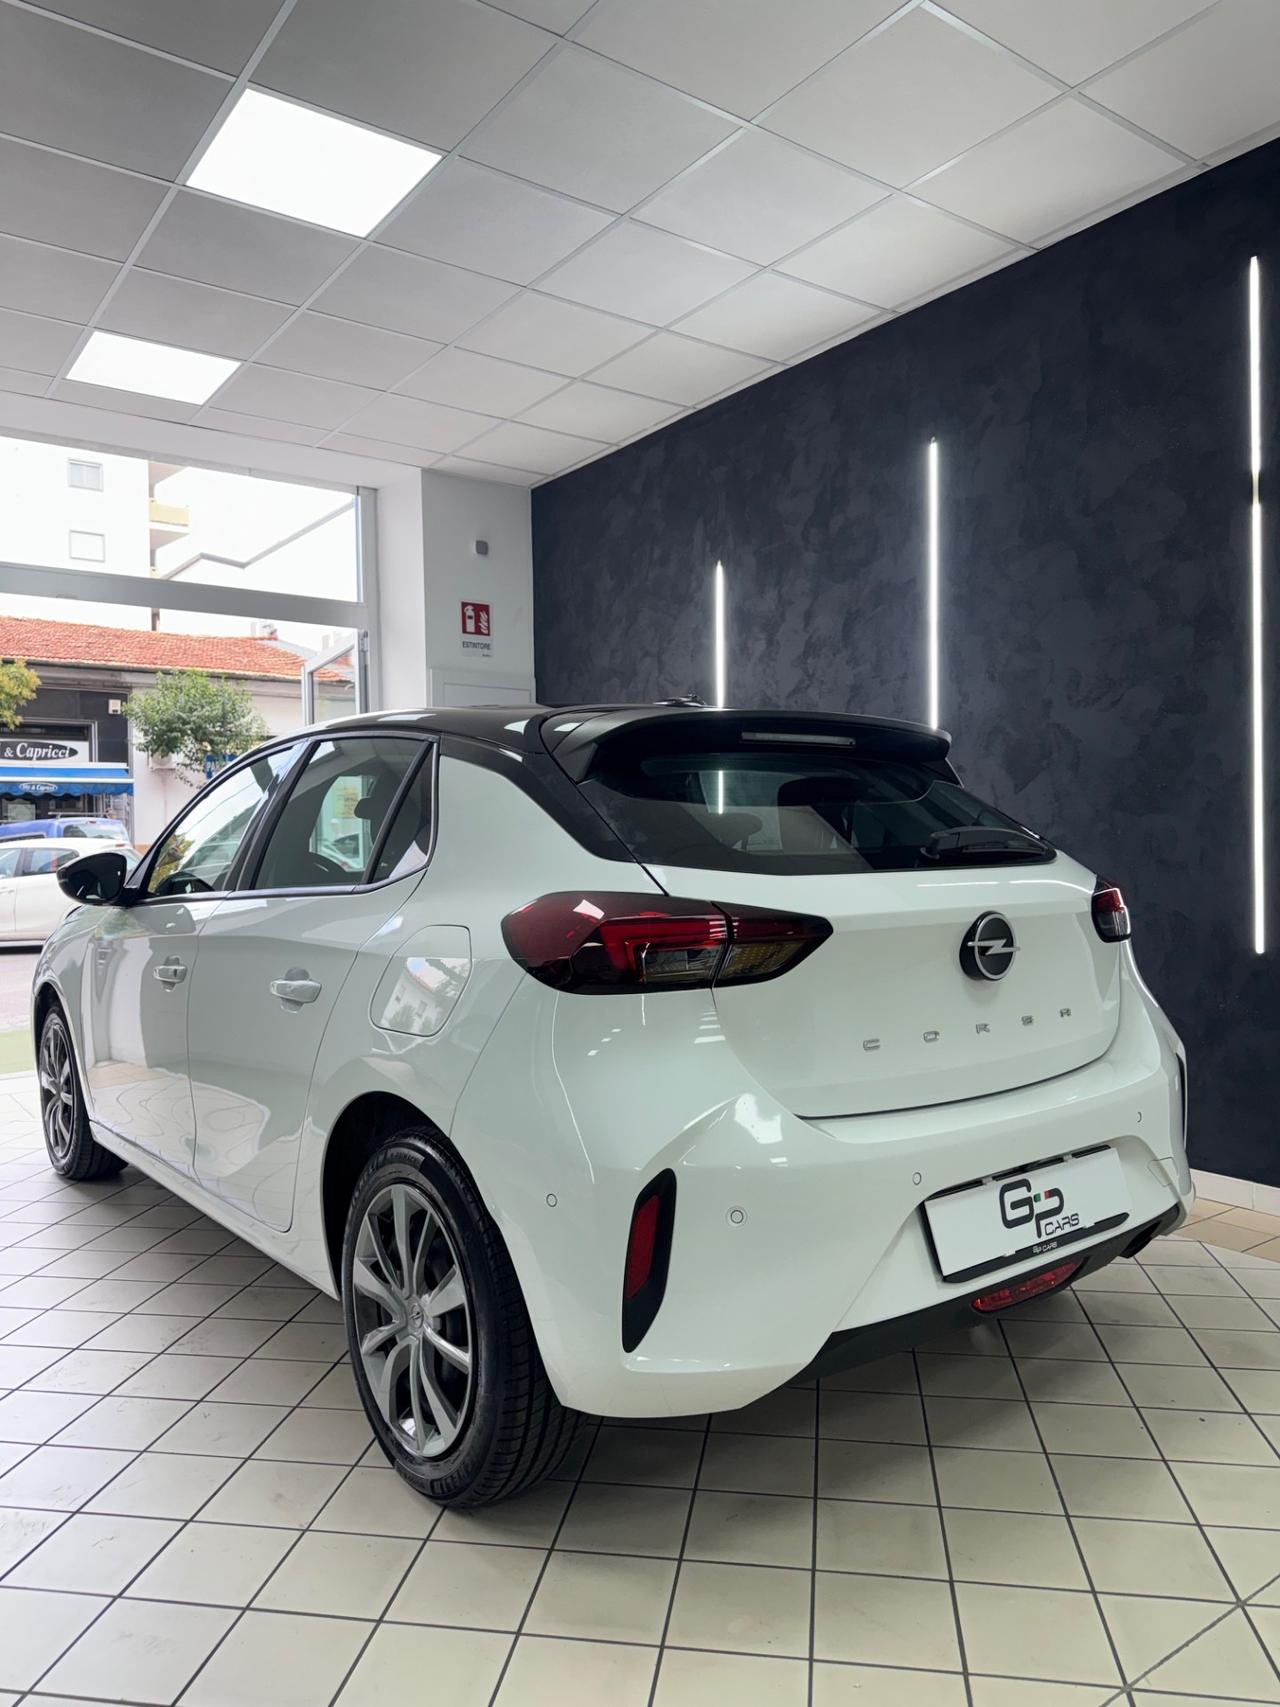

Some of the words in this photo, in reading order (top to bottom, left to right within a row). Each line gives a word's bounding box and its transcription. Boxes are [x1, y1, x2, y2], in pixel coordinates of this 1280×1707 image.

[4, 747, 14, 757] &
[16, 742, 70, 760] Capricci
[862, 1008, 1072, 1050] CORSA
[1044, 1213, 1080, 1236] CARS
